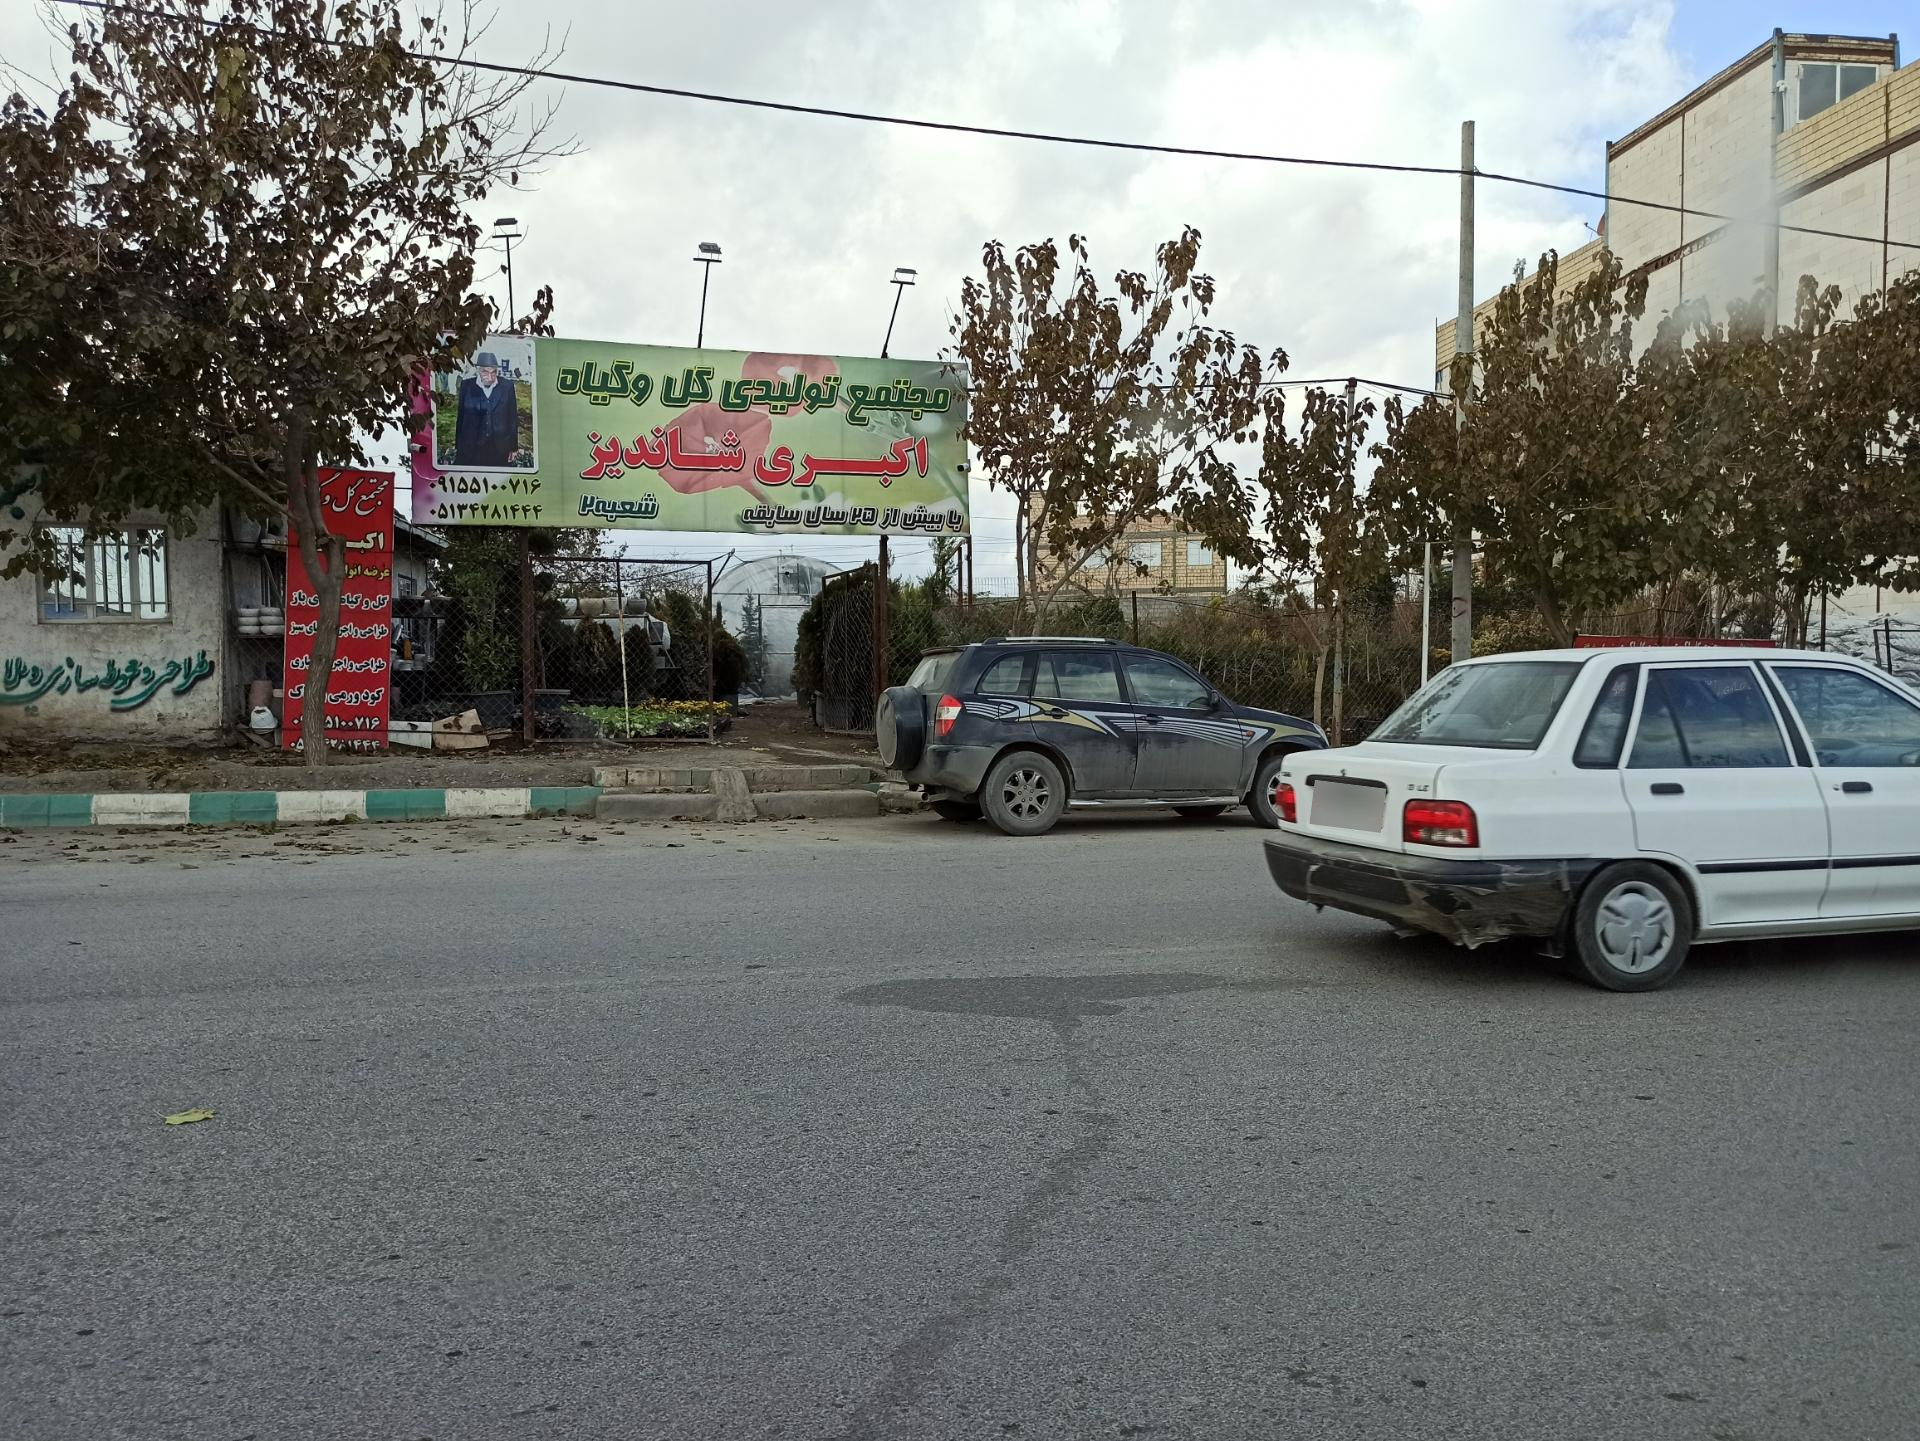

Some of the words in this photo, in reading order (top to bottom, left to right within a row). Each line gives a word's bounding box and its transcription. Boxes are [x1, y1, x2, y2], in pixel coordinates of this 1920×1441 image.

[661, 366, 714, 406] گل
[720, 374, 842, 414] تولیدی
[846, 377, 951, 425] مجتمع
[580, 425, 746, 480] شاندیز
[754, 436, 928, 486] اکبری
[332, 478, 364, 512] گل
[429, 476, 541, 495] ۰۹۱۵۵۱۰۰۷۱۶
[322, 495, 331, 504] و
[355, 479, 389, 516] مجتمع
[430, 503, 542, 520] ۰۵۱۳۴۲۸۱۴۴۴
[742, 504, 802, 528] سابقه
[803, 506, 848, 527] سال
[851, 506, 878, 526] ۲۵
[880, 507, 899, 528] از
[901, 505, 946, 532] بیش
[946, 509, 964, 532] با
[345, 564, 361, 579] انوا
[364, 565, 391, 580] عرضه
[362, 599, 370, 610] و
[371, 594, 389, 610] گل
[289, 621, 305, 635] سبز
[360, 623, 389, 639] طراحی
[355, 657, 387, 673] طراحی
[111, 650, 215, 712] طراحی
[328, 690, 360, 705] ورمی
[362, 688, 385, 706] کود
